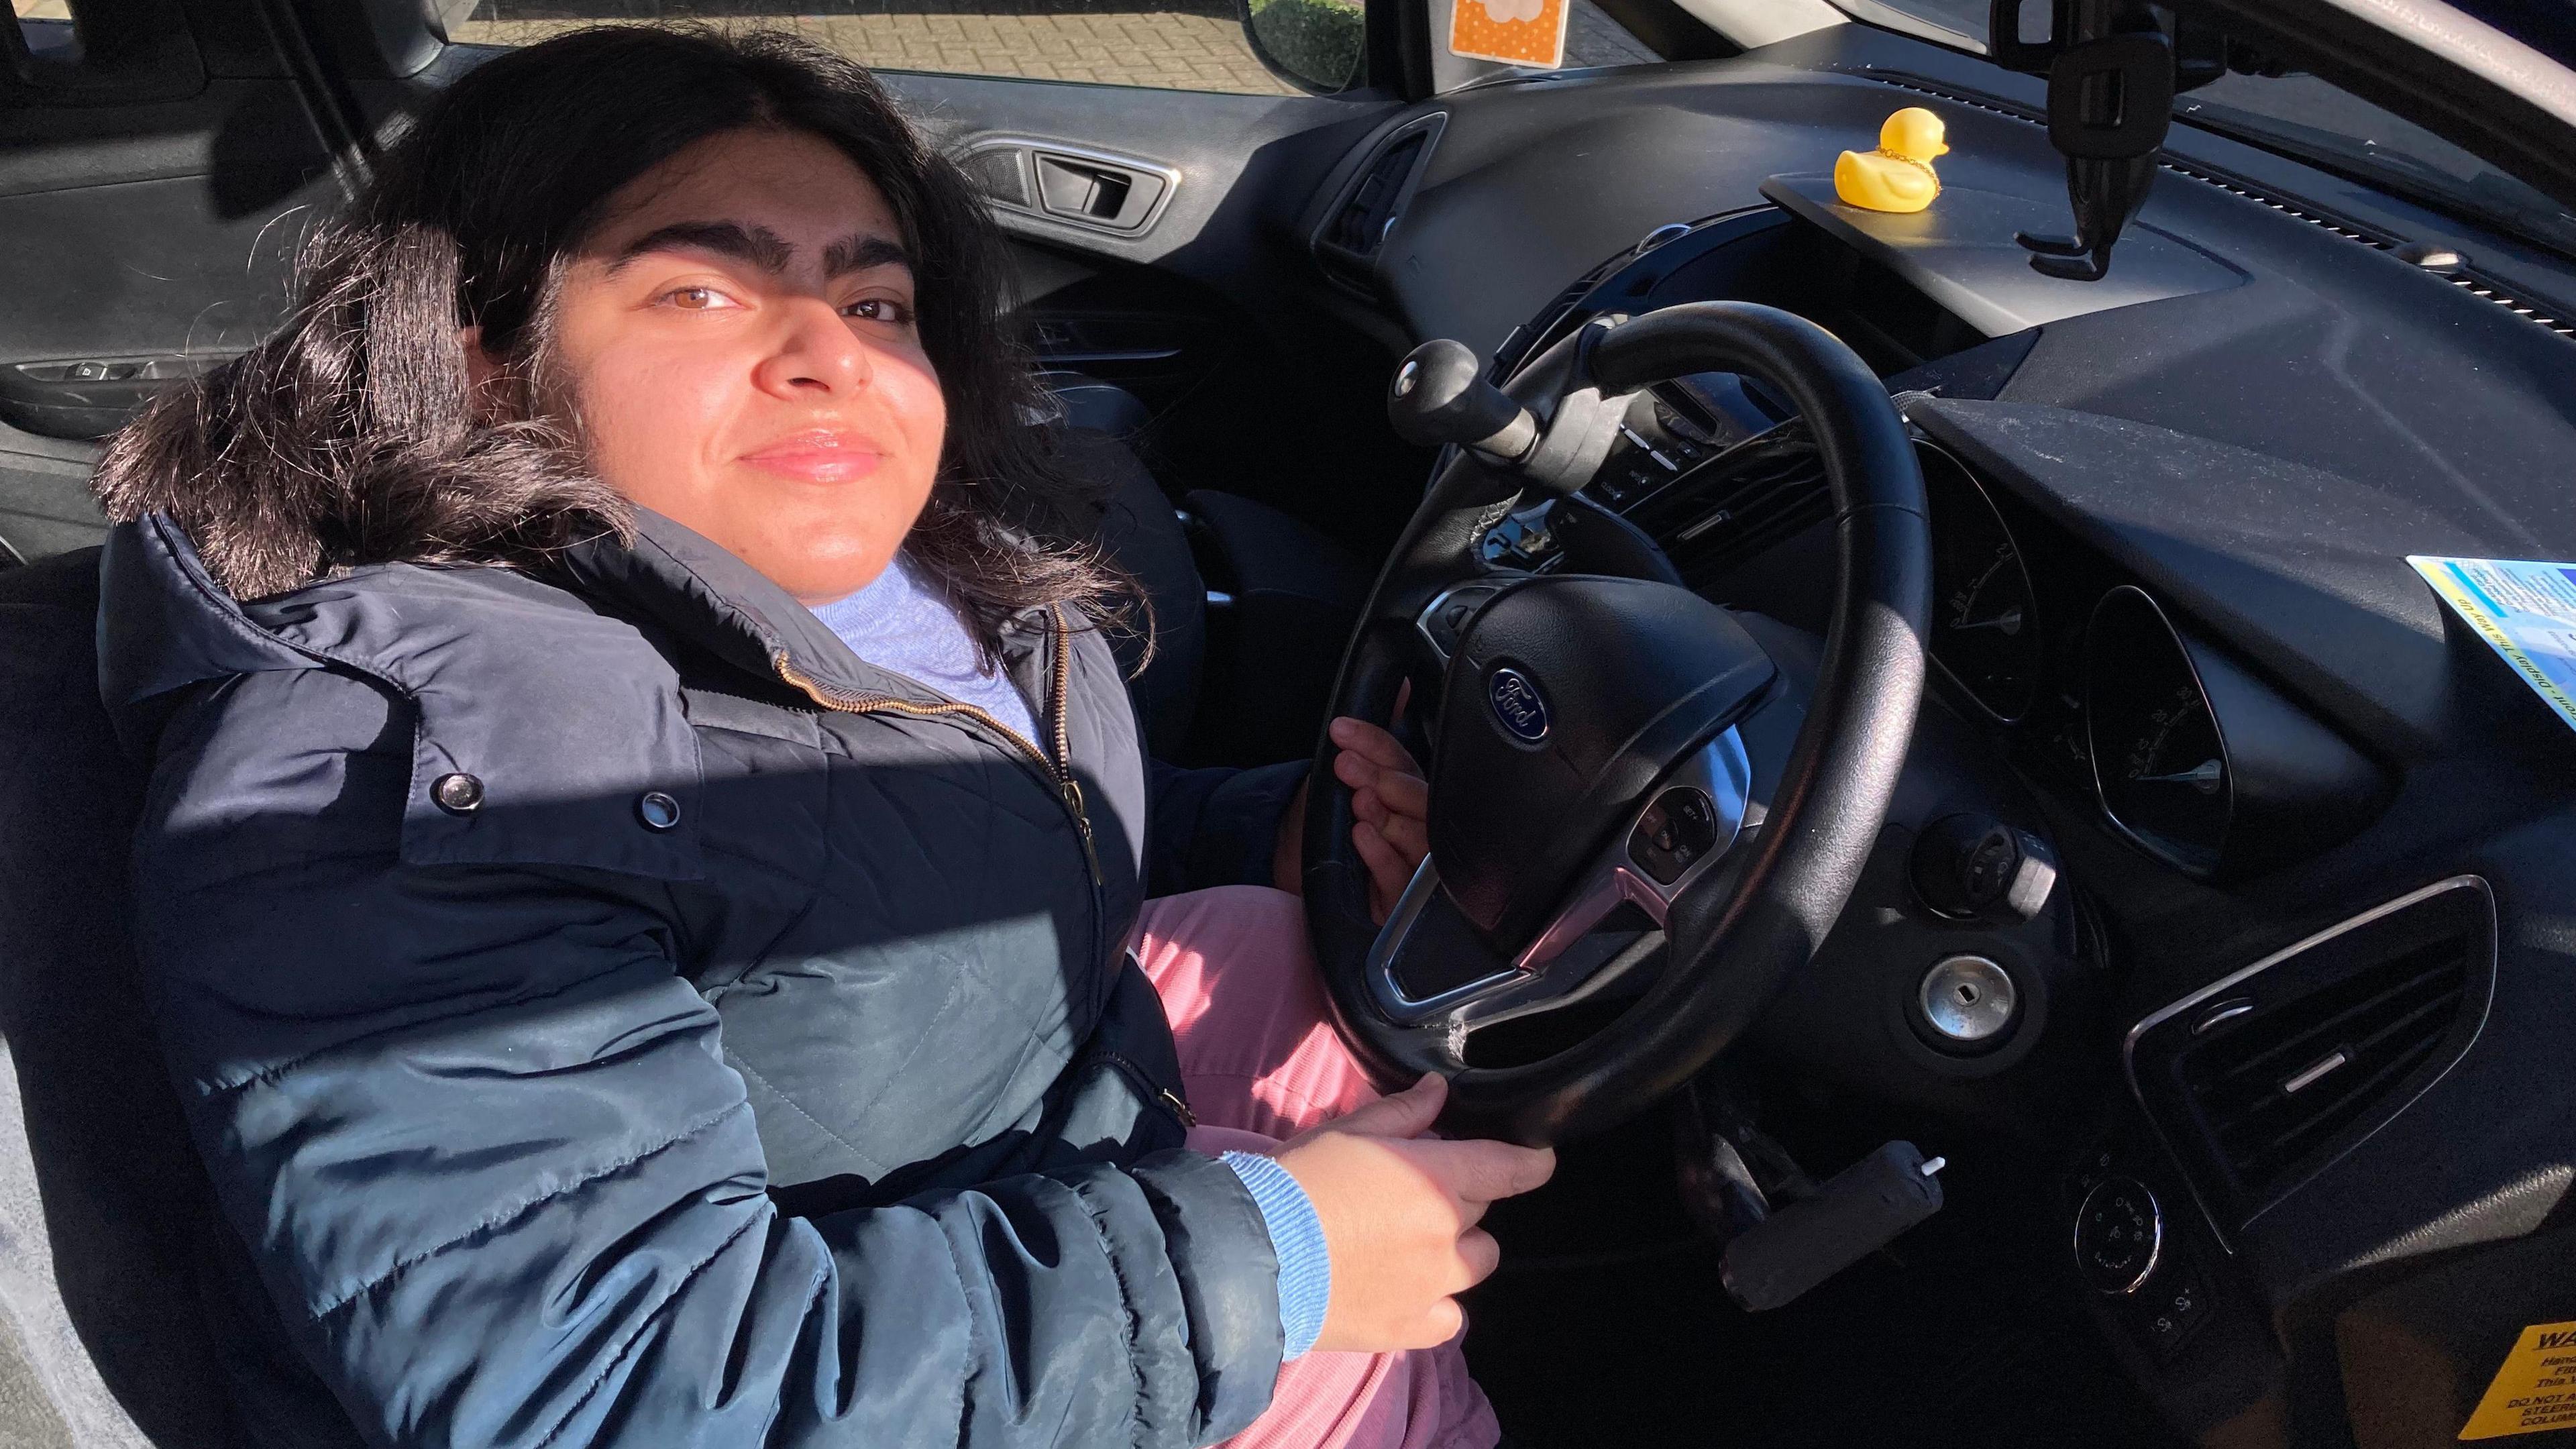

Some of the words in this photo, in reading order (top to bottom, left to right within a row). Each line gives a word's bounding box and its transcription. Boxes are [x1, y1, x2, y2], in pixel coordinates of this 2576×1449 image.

[2471, 612, 2495, 631] Way
[2492, 634, 2515, 653] This
[2513, 655, 2553, 688] Display
[1495, 678, 1536, 727] Ford
[2507, 1398, 2530, 1409] DO
[2531, 1393, 2565, 1405] NOT
